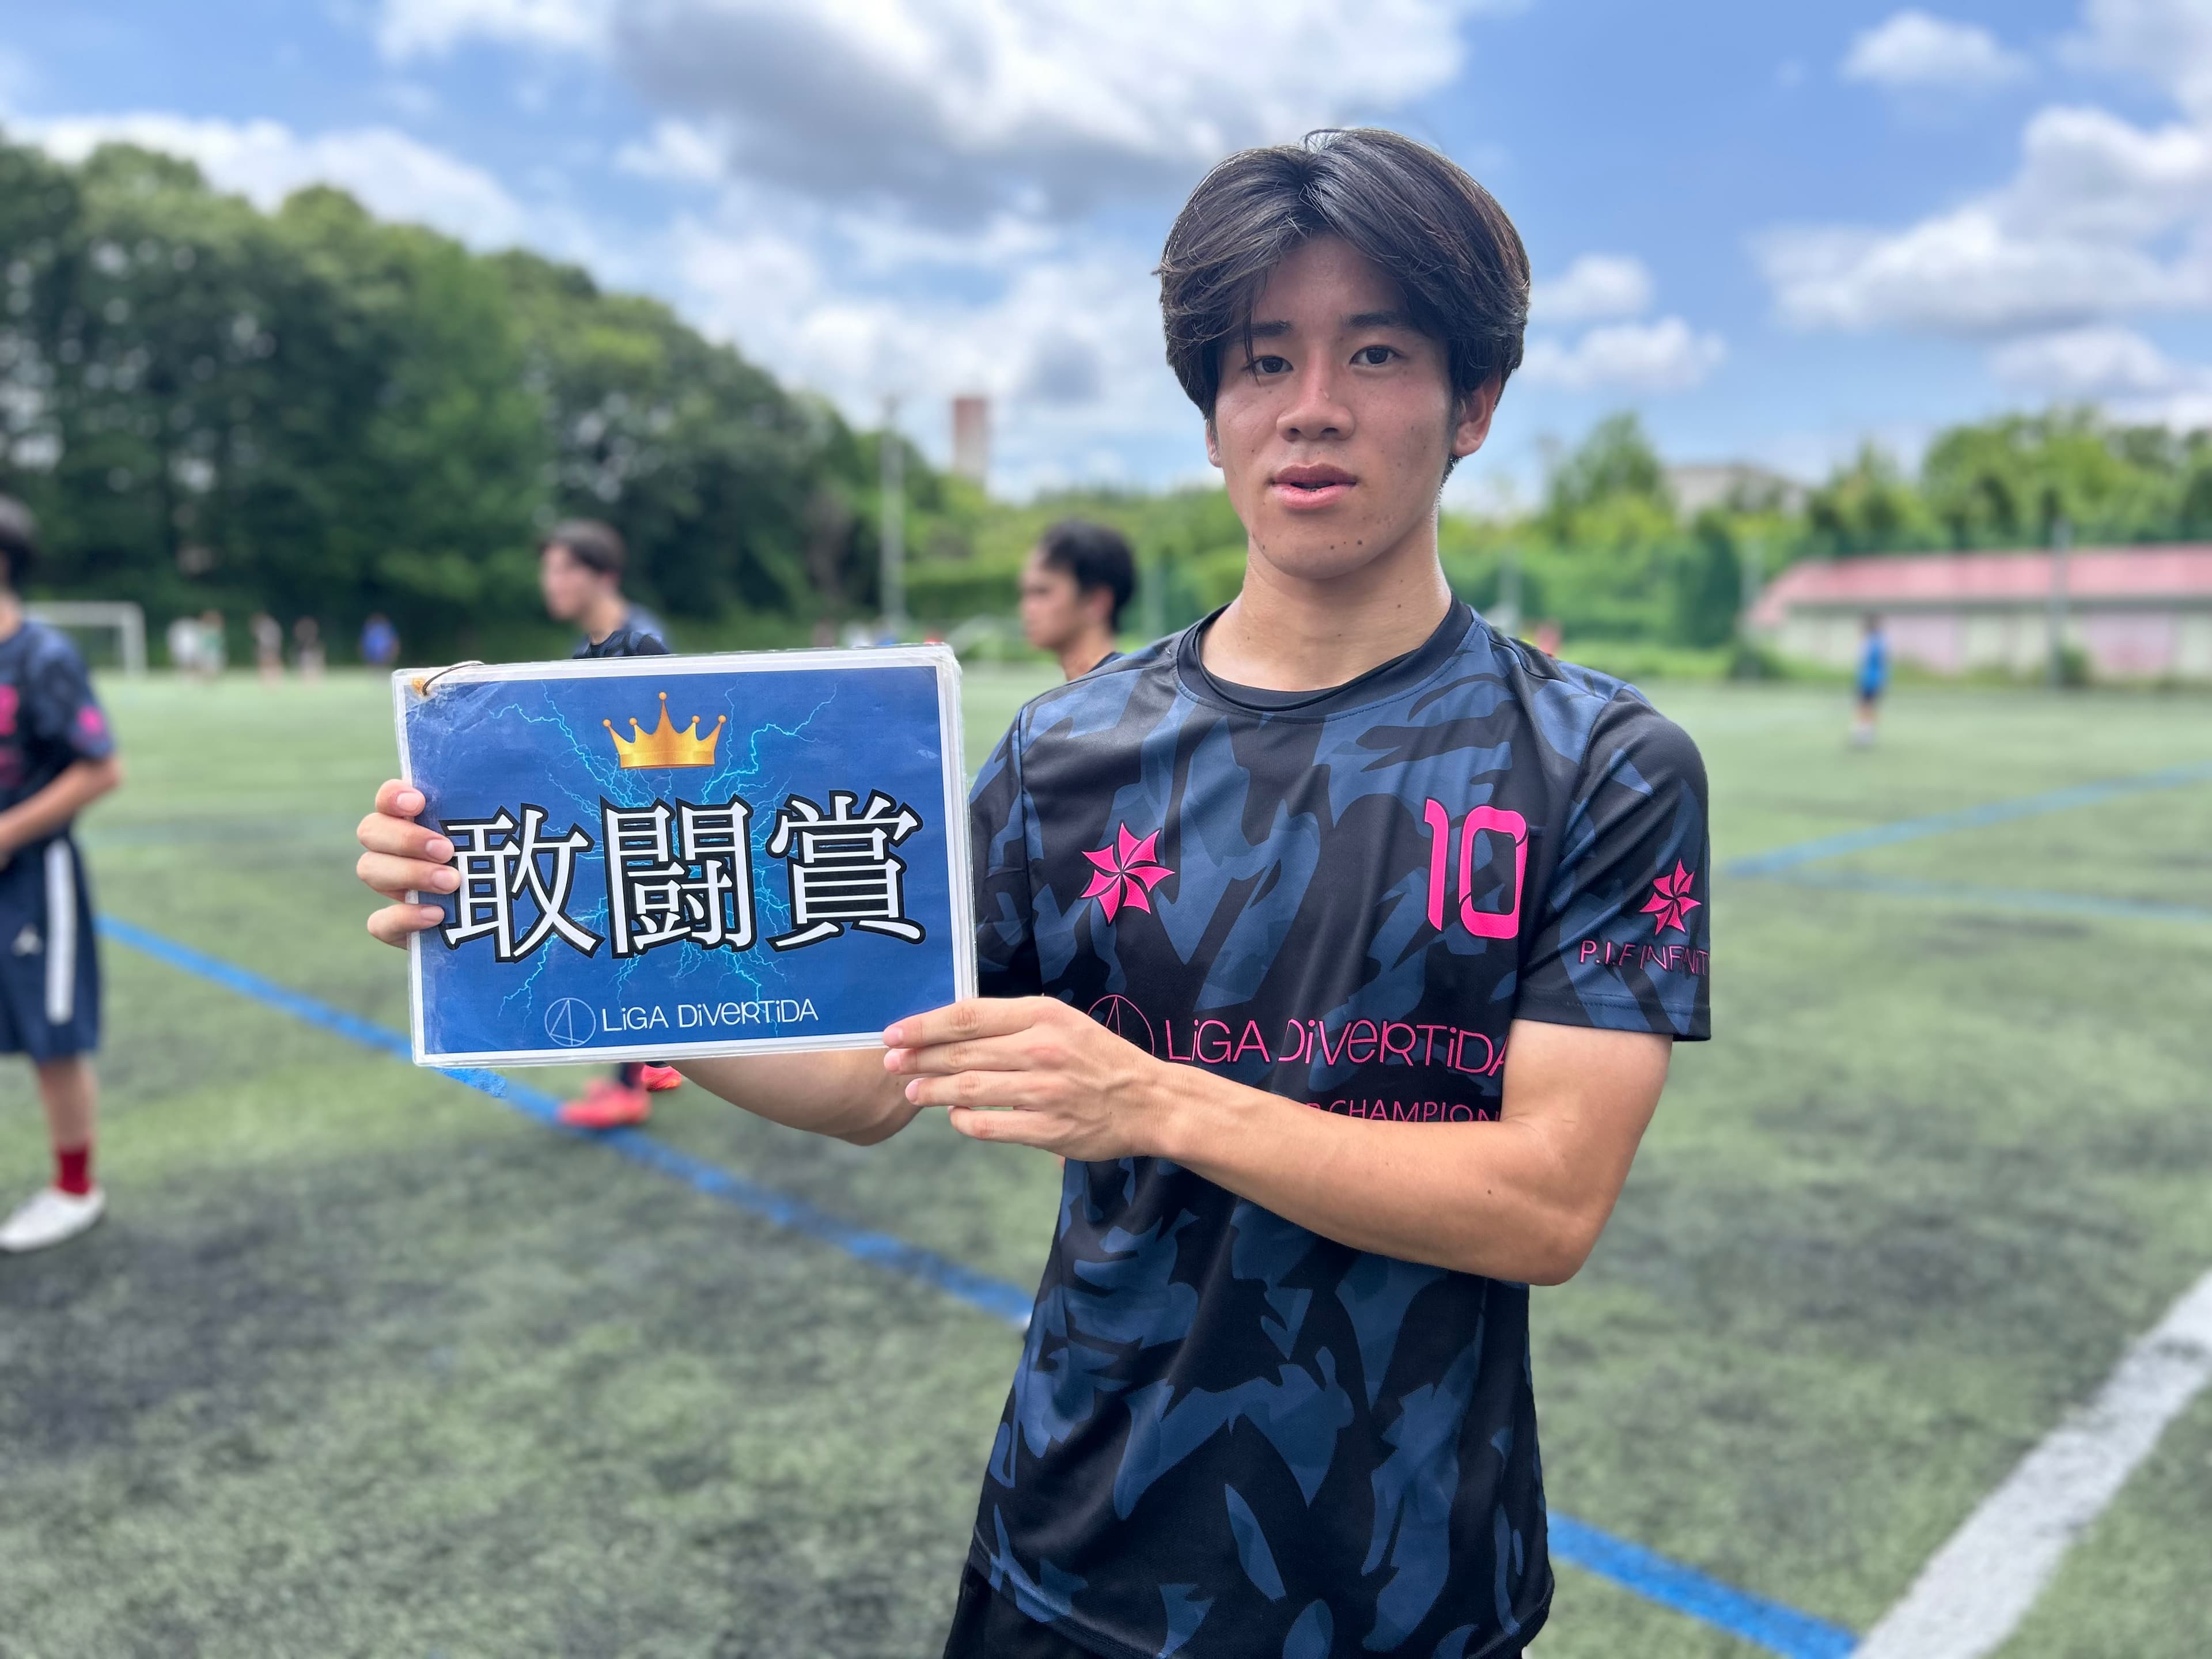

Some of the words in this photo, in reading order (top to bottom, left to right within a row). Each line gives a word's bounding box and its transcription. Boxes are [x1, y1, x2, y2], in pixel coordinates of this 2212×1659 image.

[440, 790, 926, 963] 敢闘賞
[1424, 798, 1529, 940] 10
[1639, 945, 1710, 976] INFINIT
